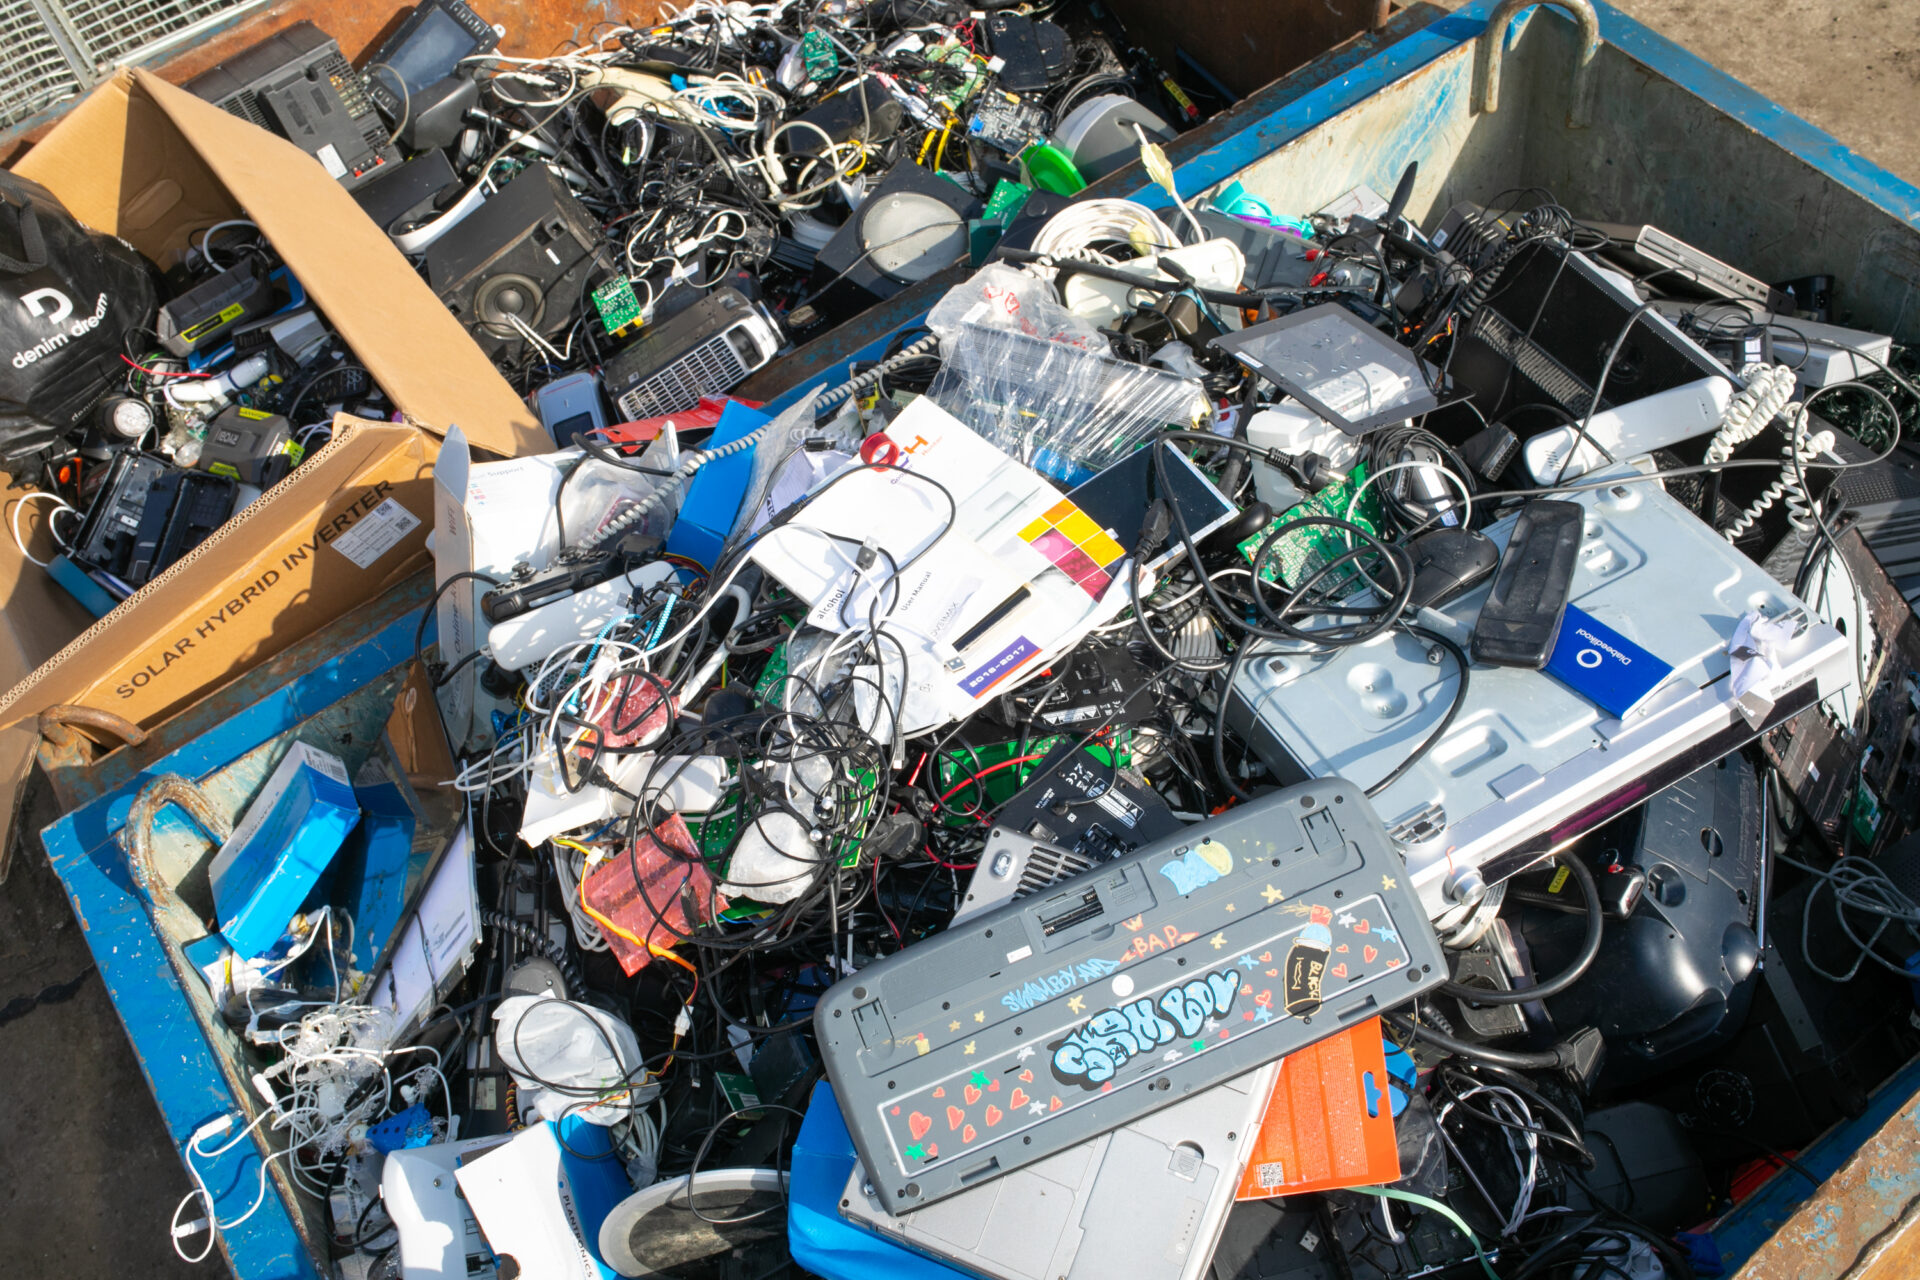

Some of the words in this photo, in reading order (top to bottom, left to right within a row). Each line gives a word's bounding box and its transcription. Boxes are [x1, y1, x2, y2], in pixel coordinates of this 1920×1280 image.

[12, 332, 70, 369] denim
[70, 292, 109, 338] dream
[116, 637, 196, 700] SOLAR
[195, 570, 280, 639] HYBRID
[282, 480, 394, 571] INVERTER
[816, 588, 846, 620] alcohol
[901, 593, 914, 612] User
[912, 571, 932, 597] Manual
[968, 644, 1027, 689] 2016-2017
[1575, 628, 1632, 666] Diabeedikool
[562, 1194, 594, 1278] PLANTRONICS
